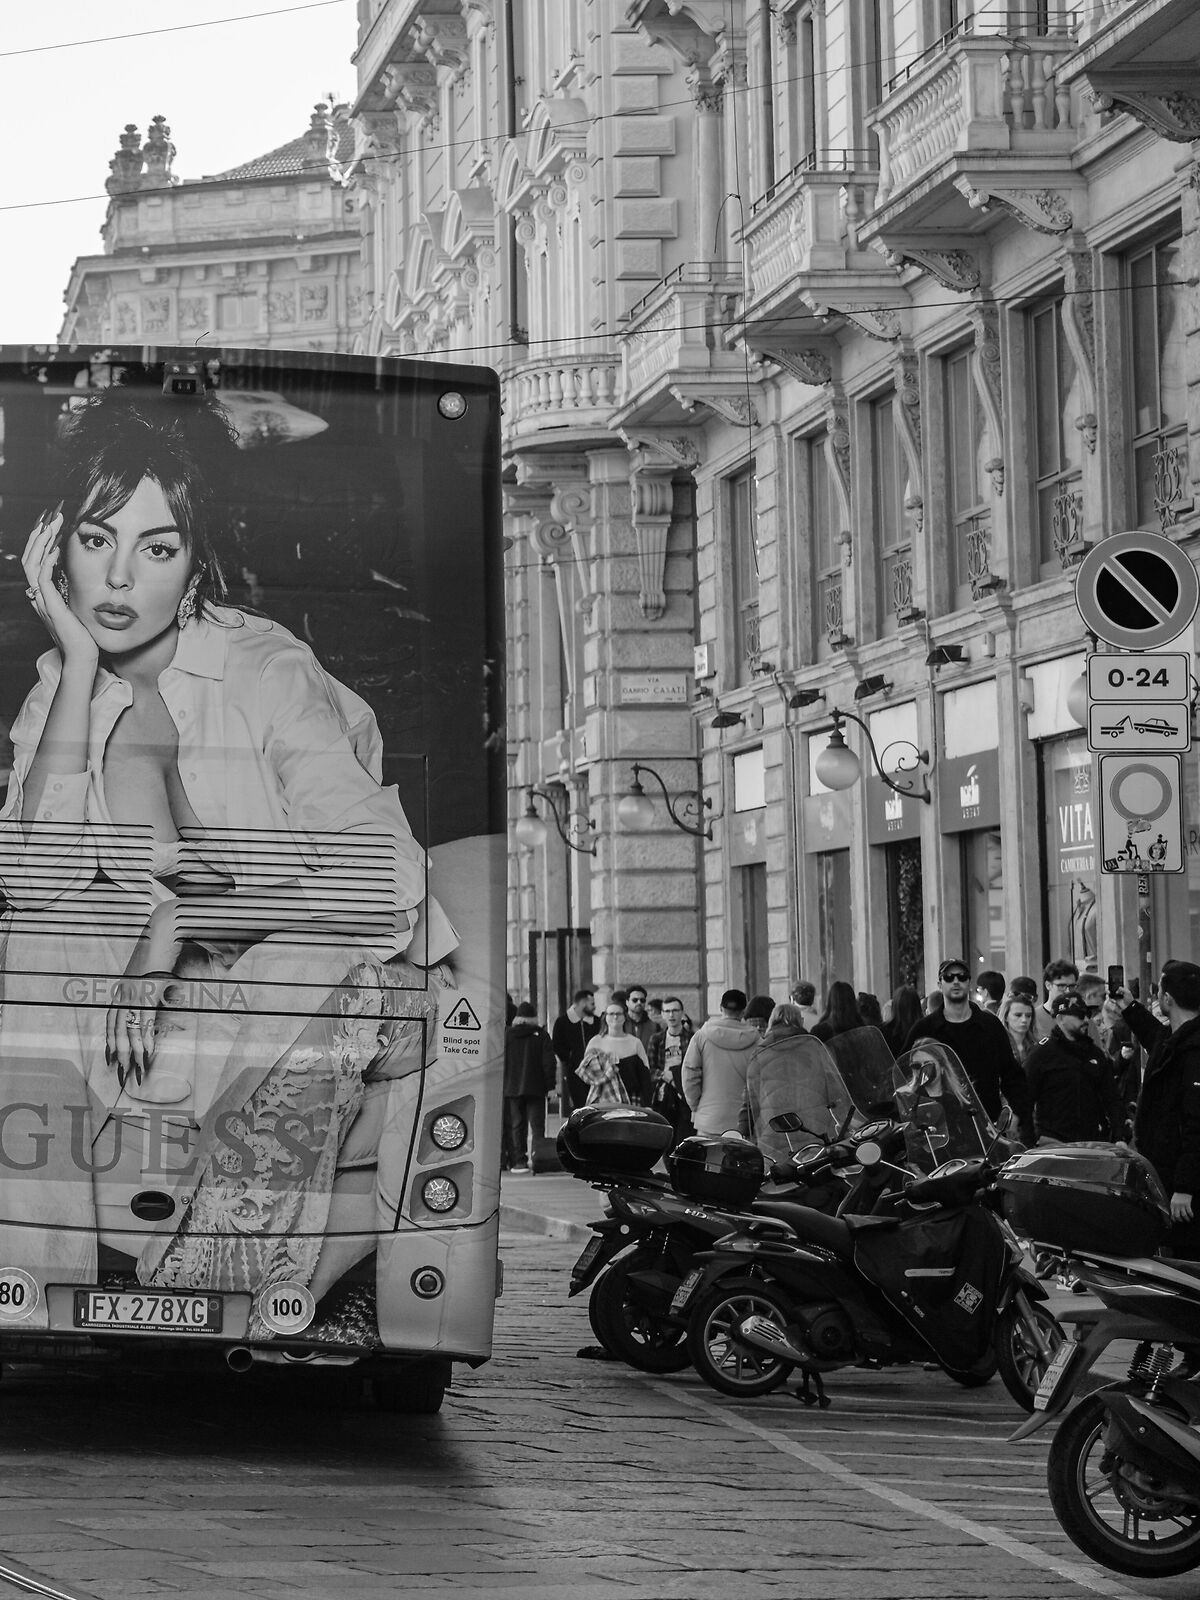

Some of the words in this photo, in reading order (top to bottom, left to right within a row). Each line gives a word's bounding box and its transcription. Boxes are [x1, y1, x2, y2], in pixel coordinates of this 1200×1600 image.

[1108, 668, 1169, 688] 0-24
[653, 686, 686, 694] CASATI
[1059, 802, 1094, 843] VITA
[62, 978, 249, 1010] GEORGINA
[271, 1298, 303, 1316] 100
